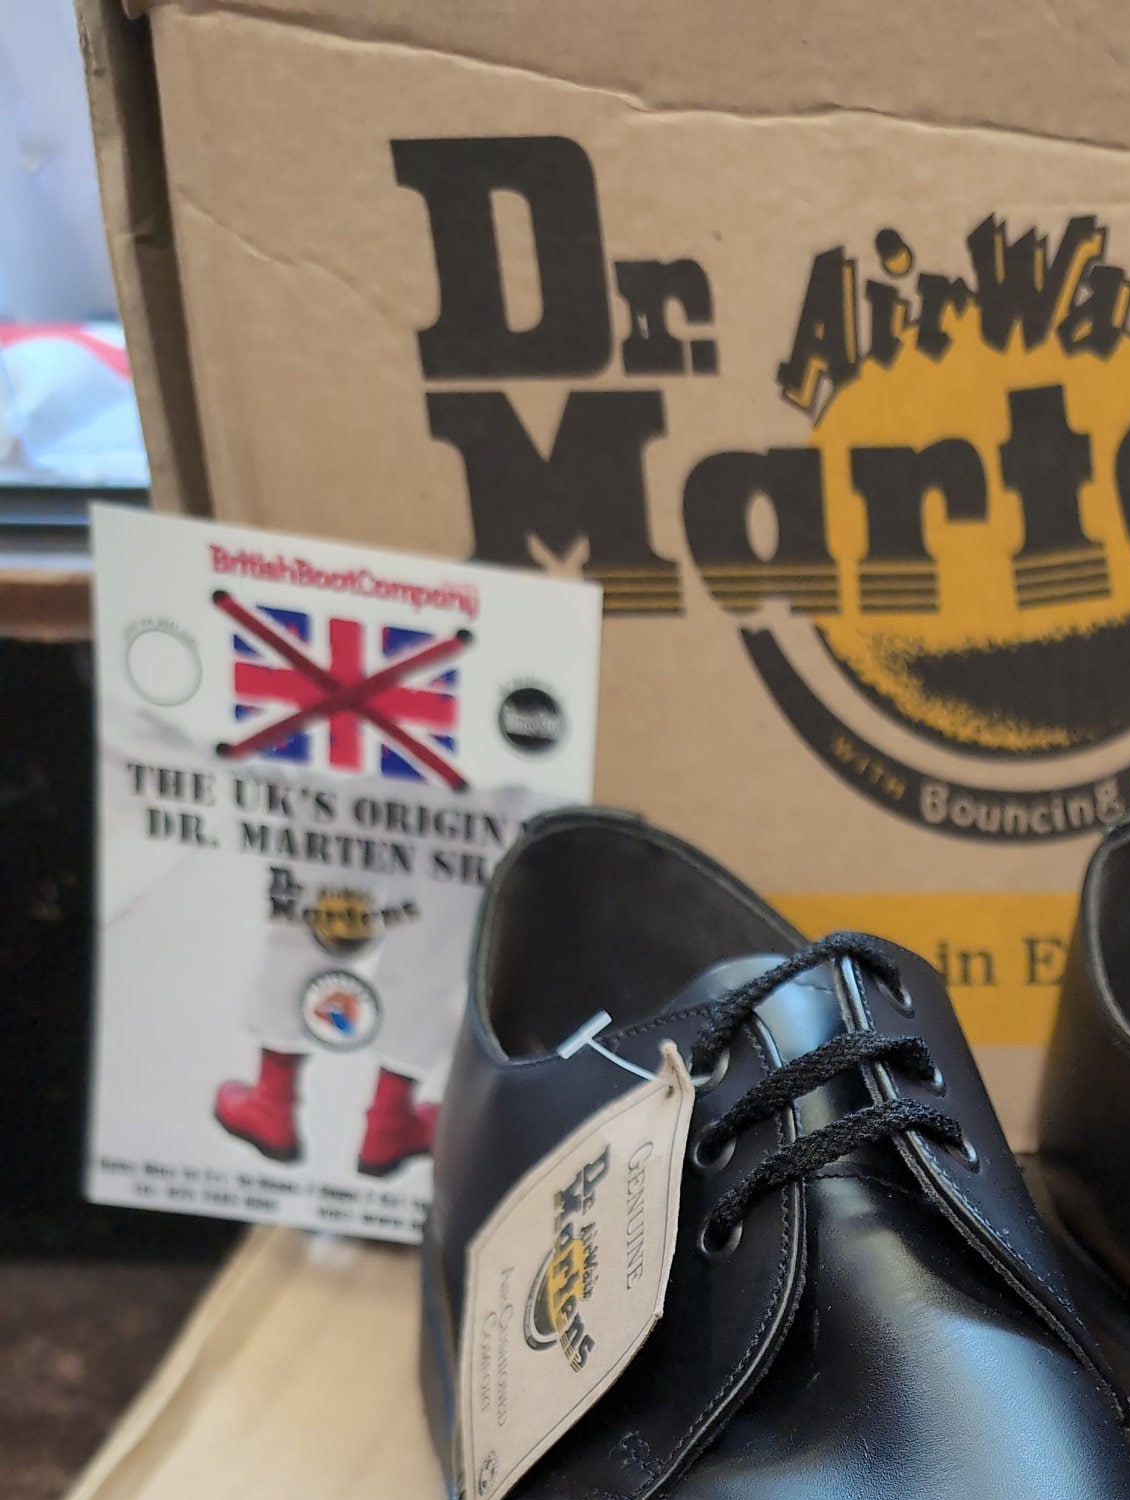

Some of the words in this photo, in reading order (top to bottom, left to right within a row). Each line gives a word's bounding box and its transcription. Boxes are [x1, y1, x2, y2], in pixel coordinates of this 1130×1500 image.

[389, 136, 718, 381] Dr.
[128, 764, 216, 806] THE
[234, 779, 337, 824] UK'S
[354, 797, 530, 845] ORIGIN
[147, 808, 220, 848] DR.
[240, 821, 413, 873] MARTEN
[432, 849, 490, 886] SH
